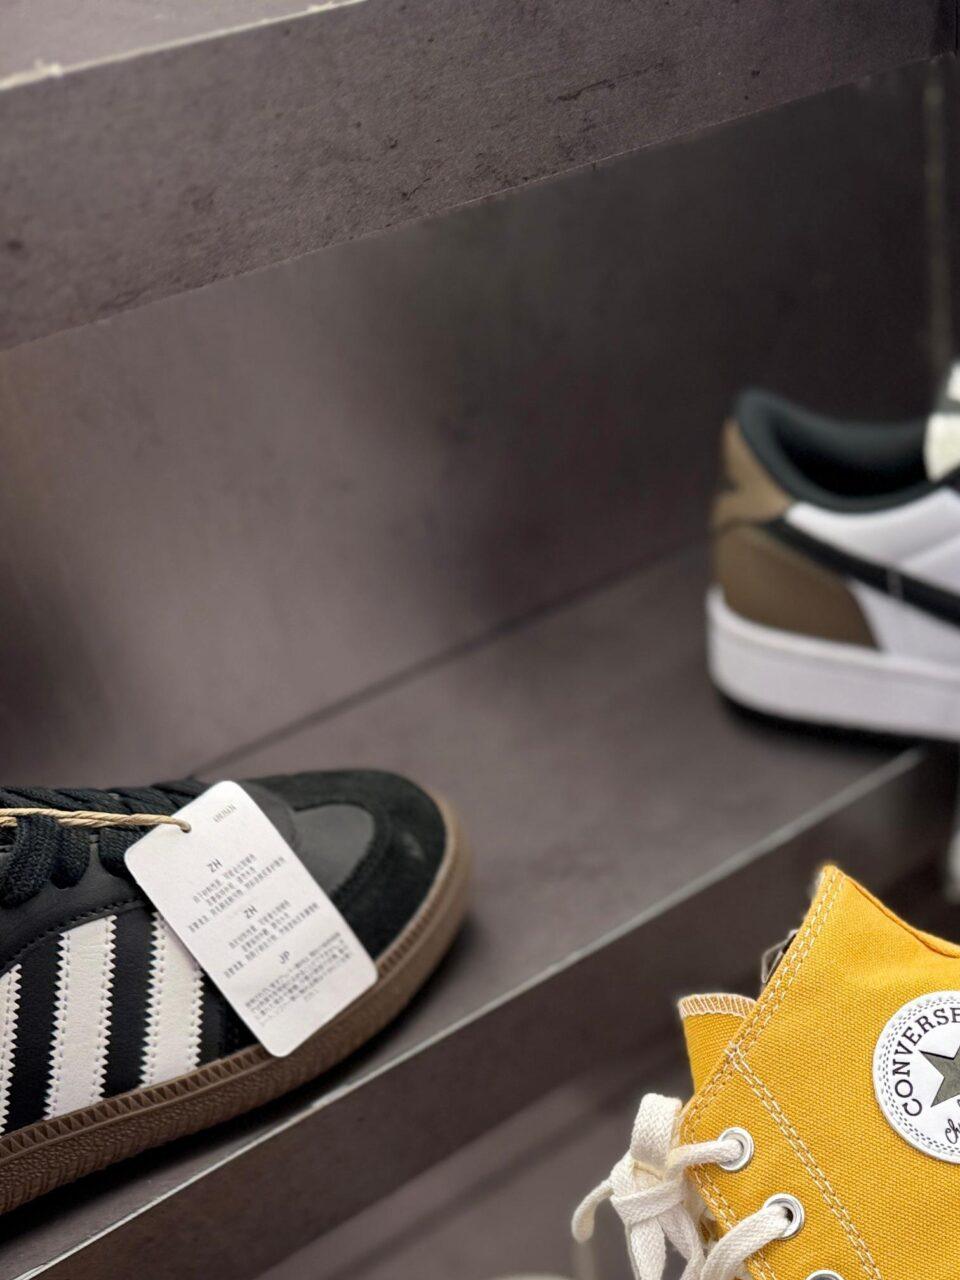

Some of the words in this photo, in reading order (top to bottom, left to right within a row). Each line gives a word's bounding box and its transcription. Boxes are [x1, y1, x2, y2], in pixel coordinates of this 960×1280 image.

[206, 858, 223, 873] ZH
[243, 904, 258, 920] ZH
[279, 951, 291, 965] JP
